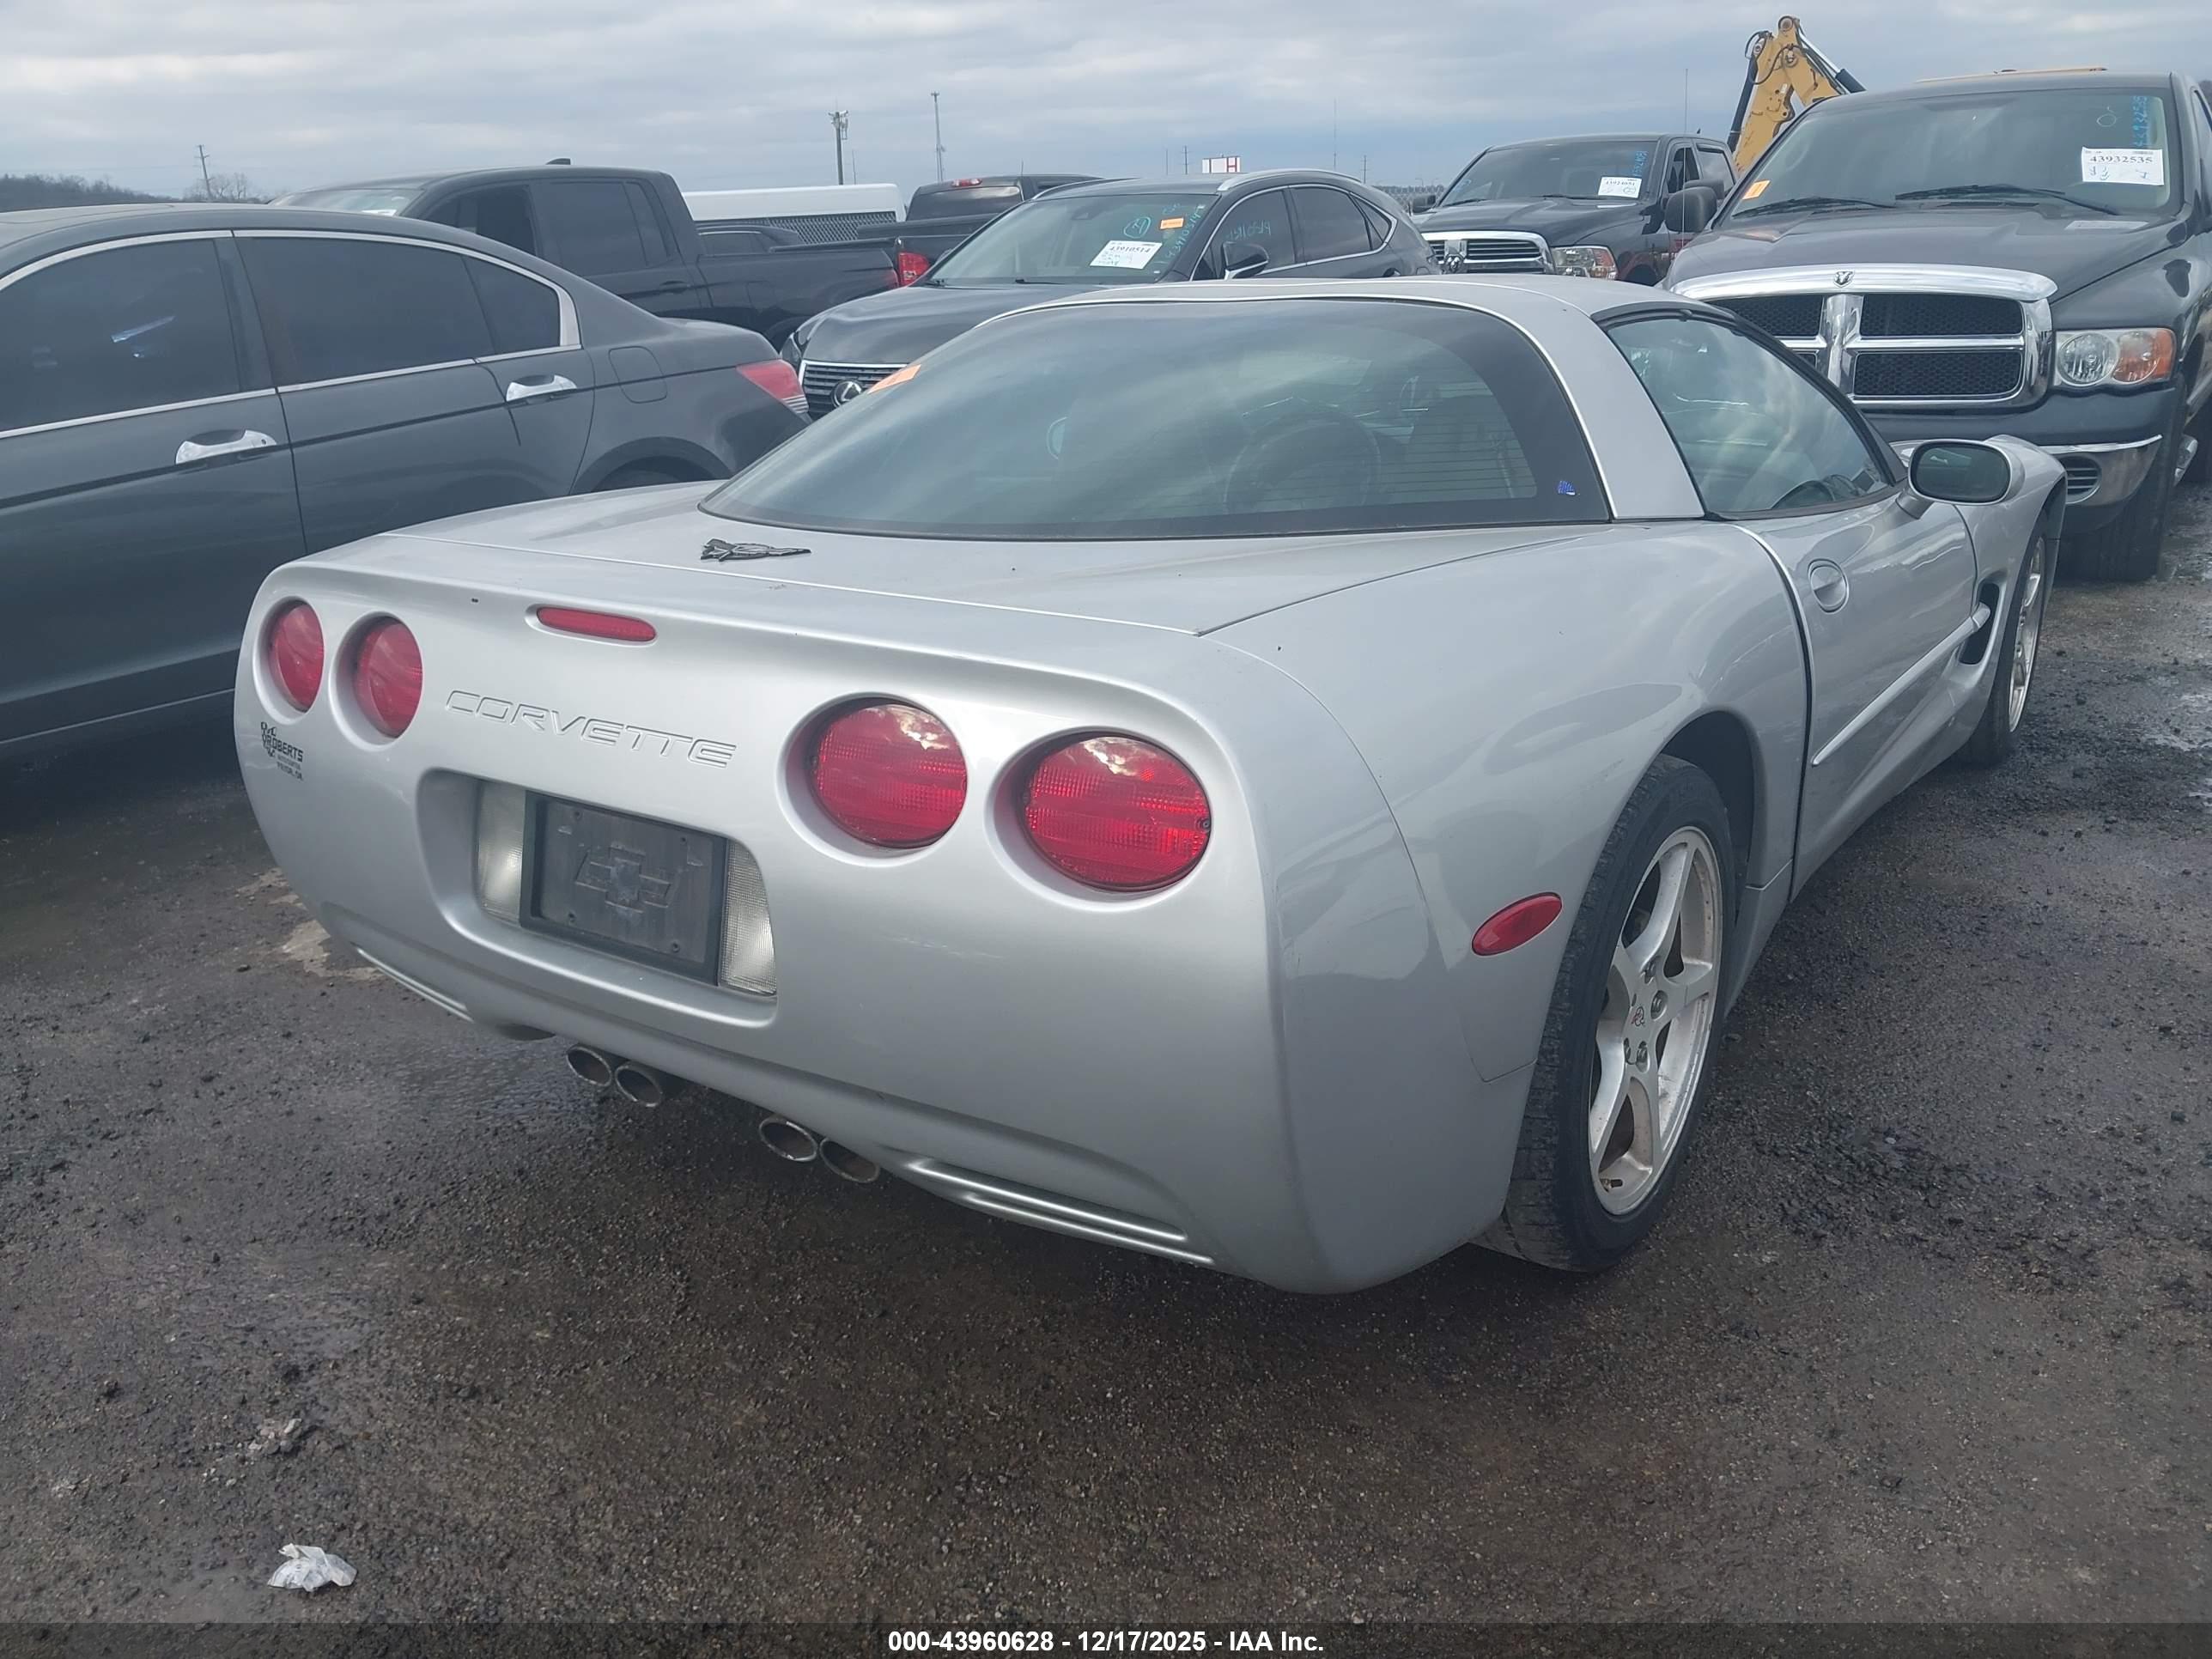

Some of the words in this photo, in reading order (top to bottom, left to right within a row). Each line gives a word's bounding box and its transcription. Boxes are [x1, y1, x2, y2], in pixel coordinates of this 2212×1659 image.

[2089, 155, 2154, 164] 43932535
[445, 690, 738, 769] CORVETTE
[266, 735, 303, 762] ROBERTS
